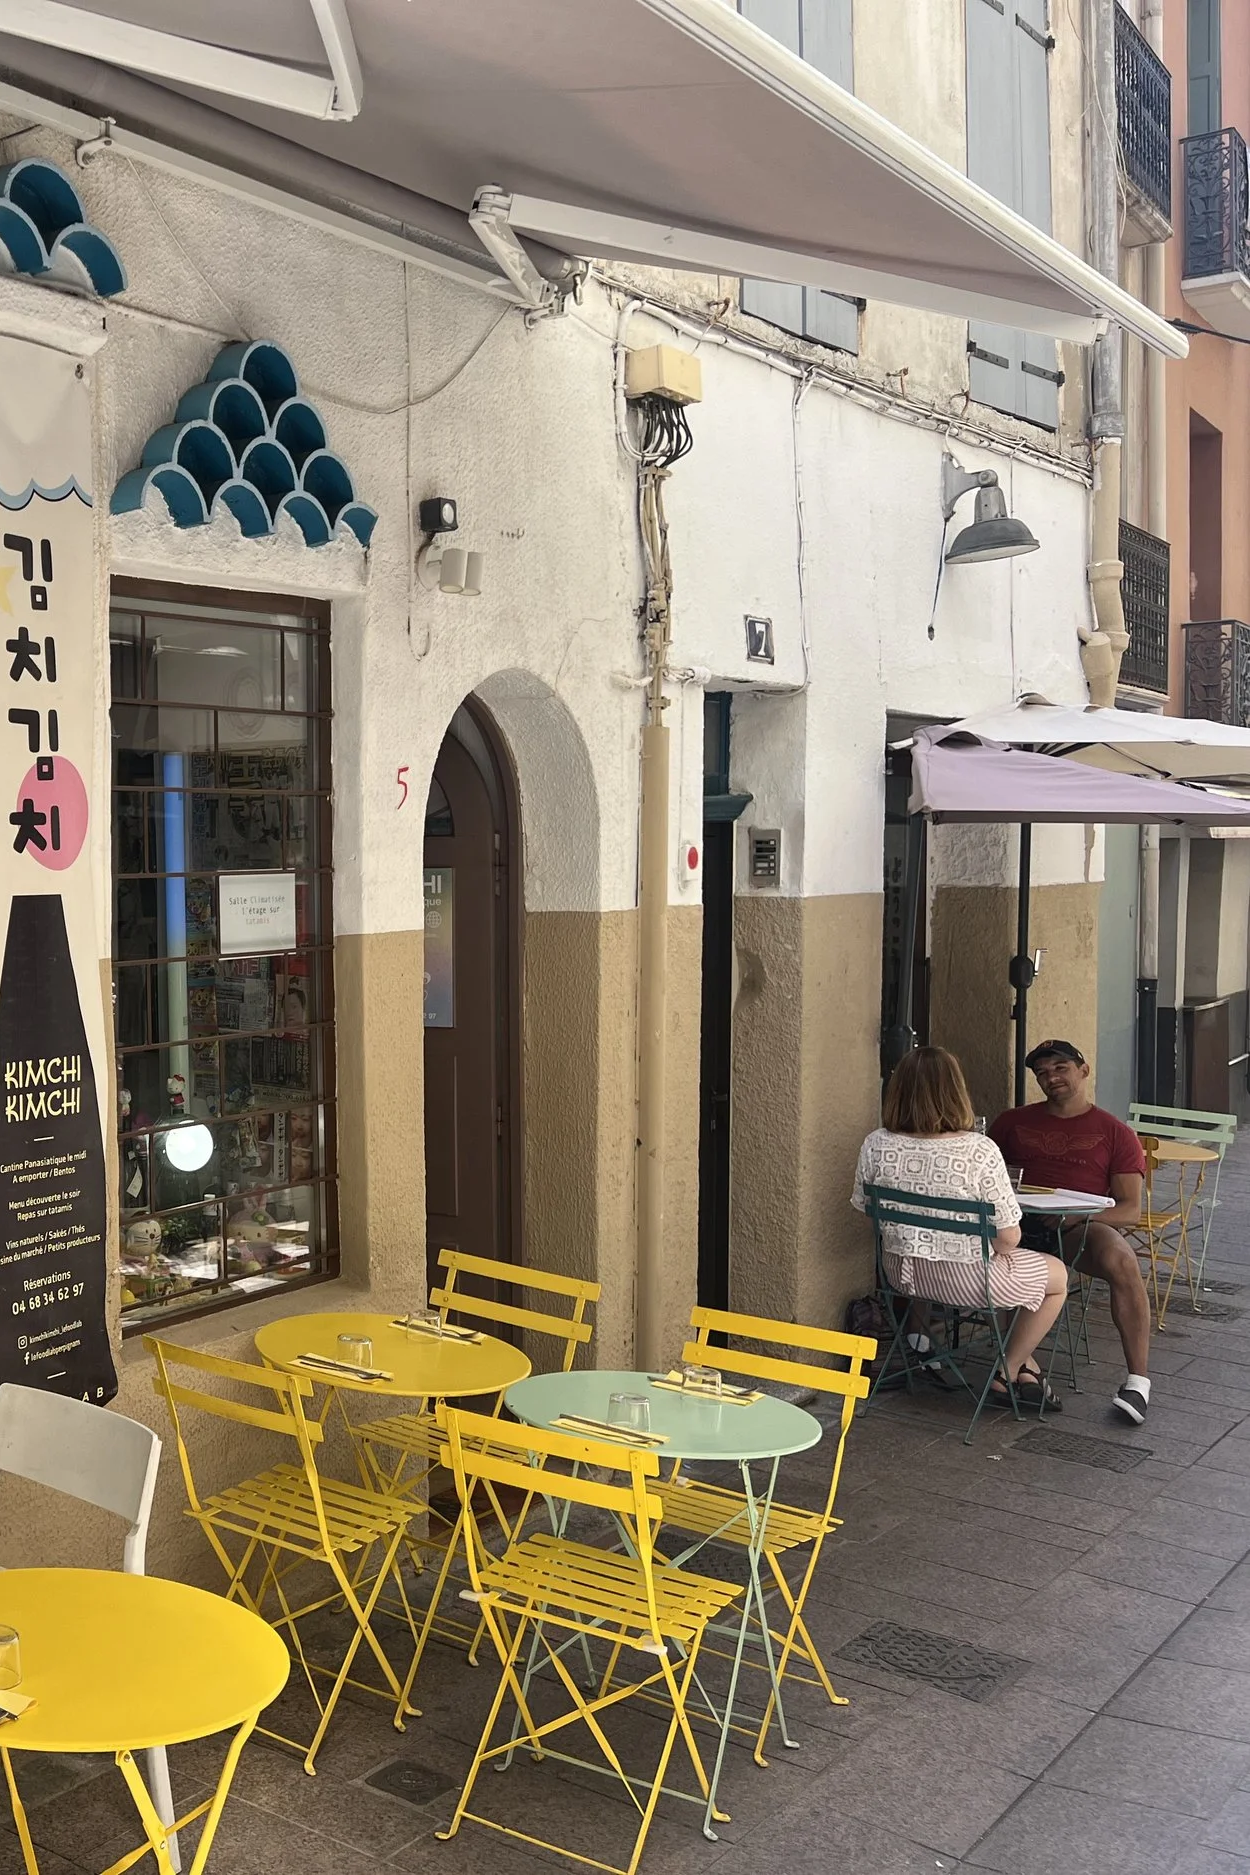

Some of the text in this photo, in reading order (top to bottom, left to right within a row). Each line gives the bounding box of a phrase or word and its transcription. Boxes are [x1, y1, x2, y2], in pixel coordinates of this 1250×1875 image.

[754, 621, 767, 656] 7
[397, 766, 409, 810] 5
[4, 1054, 81, 1090] KIMCHI
[5, 1087, 81, 1123] KIMCHI
[0, 1150, 87, 1174] Cantine Panasiatique le midi
[12, 1175, 18, 1184] A
[18, 1169, 49, 1183] emporter
[54, 1165, 76, 1177] Bentos
[8, 1189, 81, 1211] Menu découverte le soir
[17, 1203, 73, 1222] Repas sur tatamis
[6, 1239, 19, 1250] Vins
[19, 1234, 44, 1247] naturels
[49, 1229, 67, 1240] Sakés
[72, 1224, 86, 1234] Thés
[14, 1251, 21, 1261] du
[21, 1246, 43, 1259] marché
[48, 1240, 66, 1253] Petits
[67, 1234, 101, 1250] producteurs
[23, 1270, 71, 1292] Réservations
[12, 1282, 85, 1316] 04 68 34 62 97
